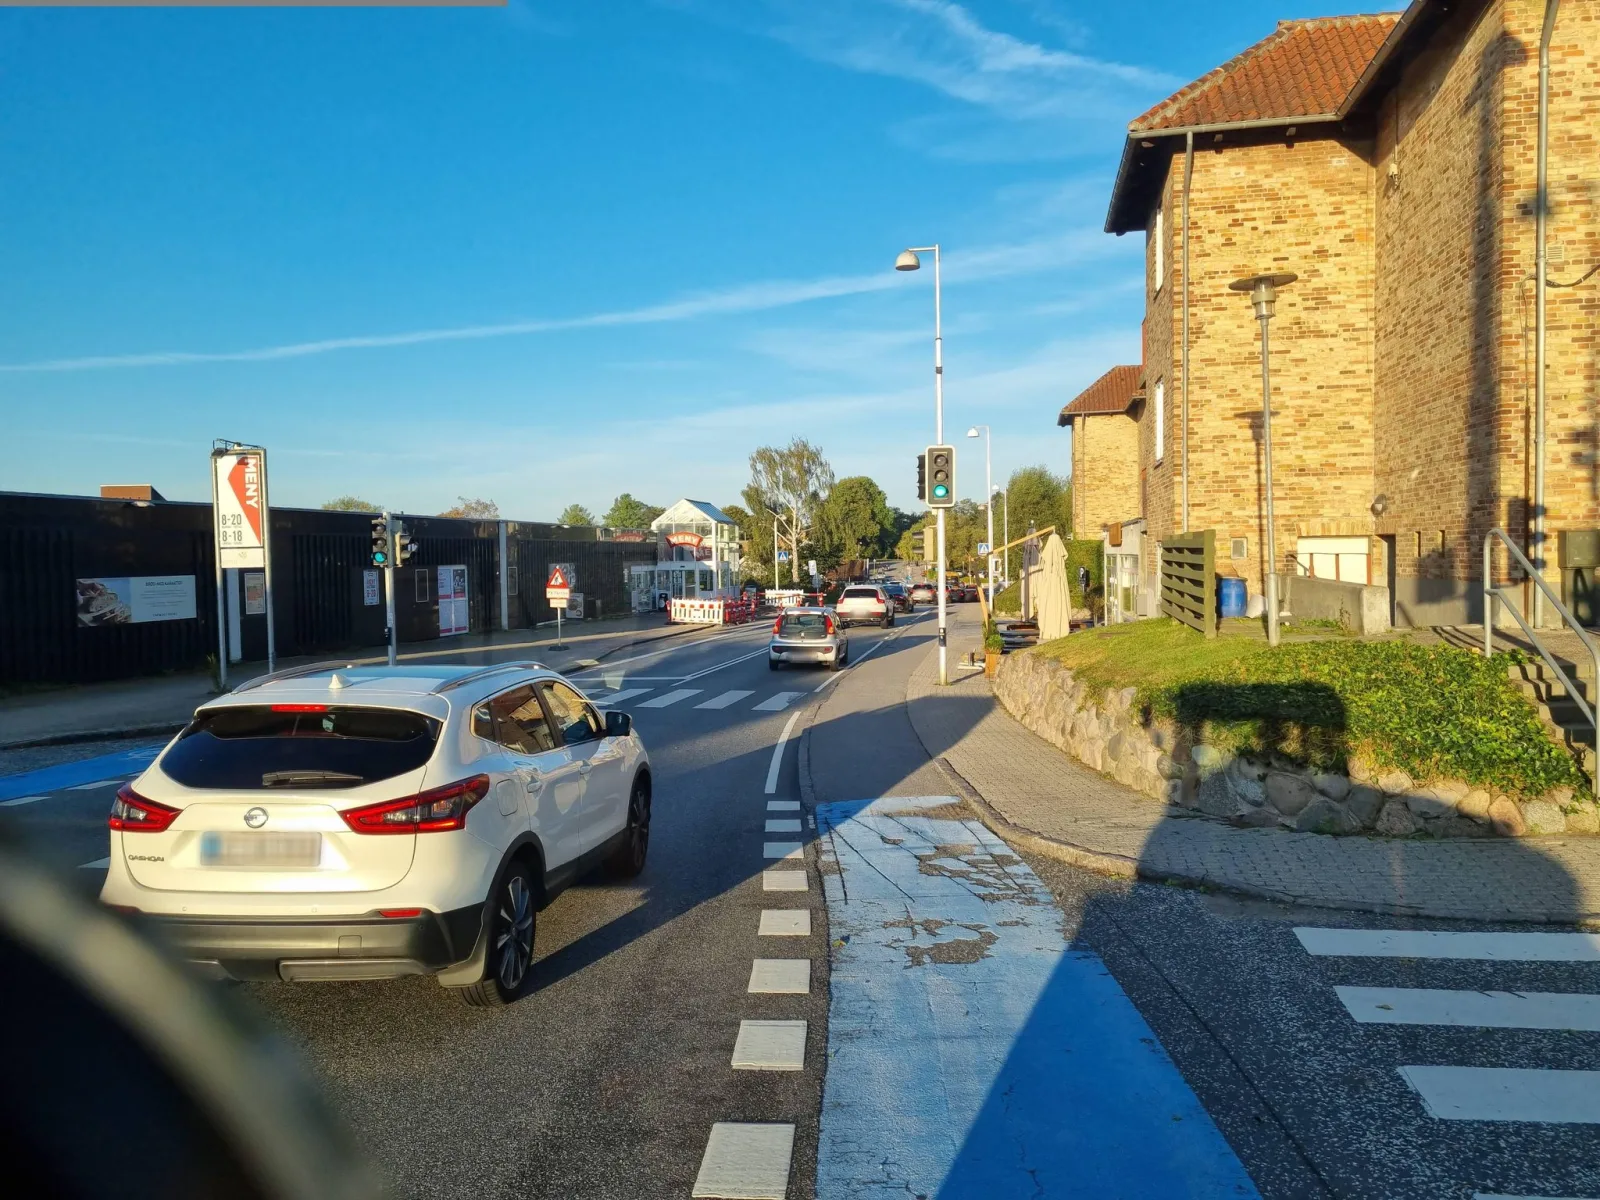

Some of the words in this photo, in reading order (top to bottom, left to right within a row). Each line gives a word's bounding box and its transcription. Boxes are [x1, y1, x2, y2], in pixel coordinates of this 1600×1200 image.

[244, 457, 259, 509] MENY
[221, 513, 242, 526] 8-20
[222, 530, 243, 542] 8-18
[671, 534, 698, 545] MENY
[128, 854, 164, 862] QASHQAI
